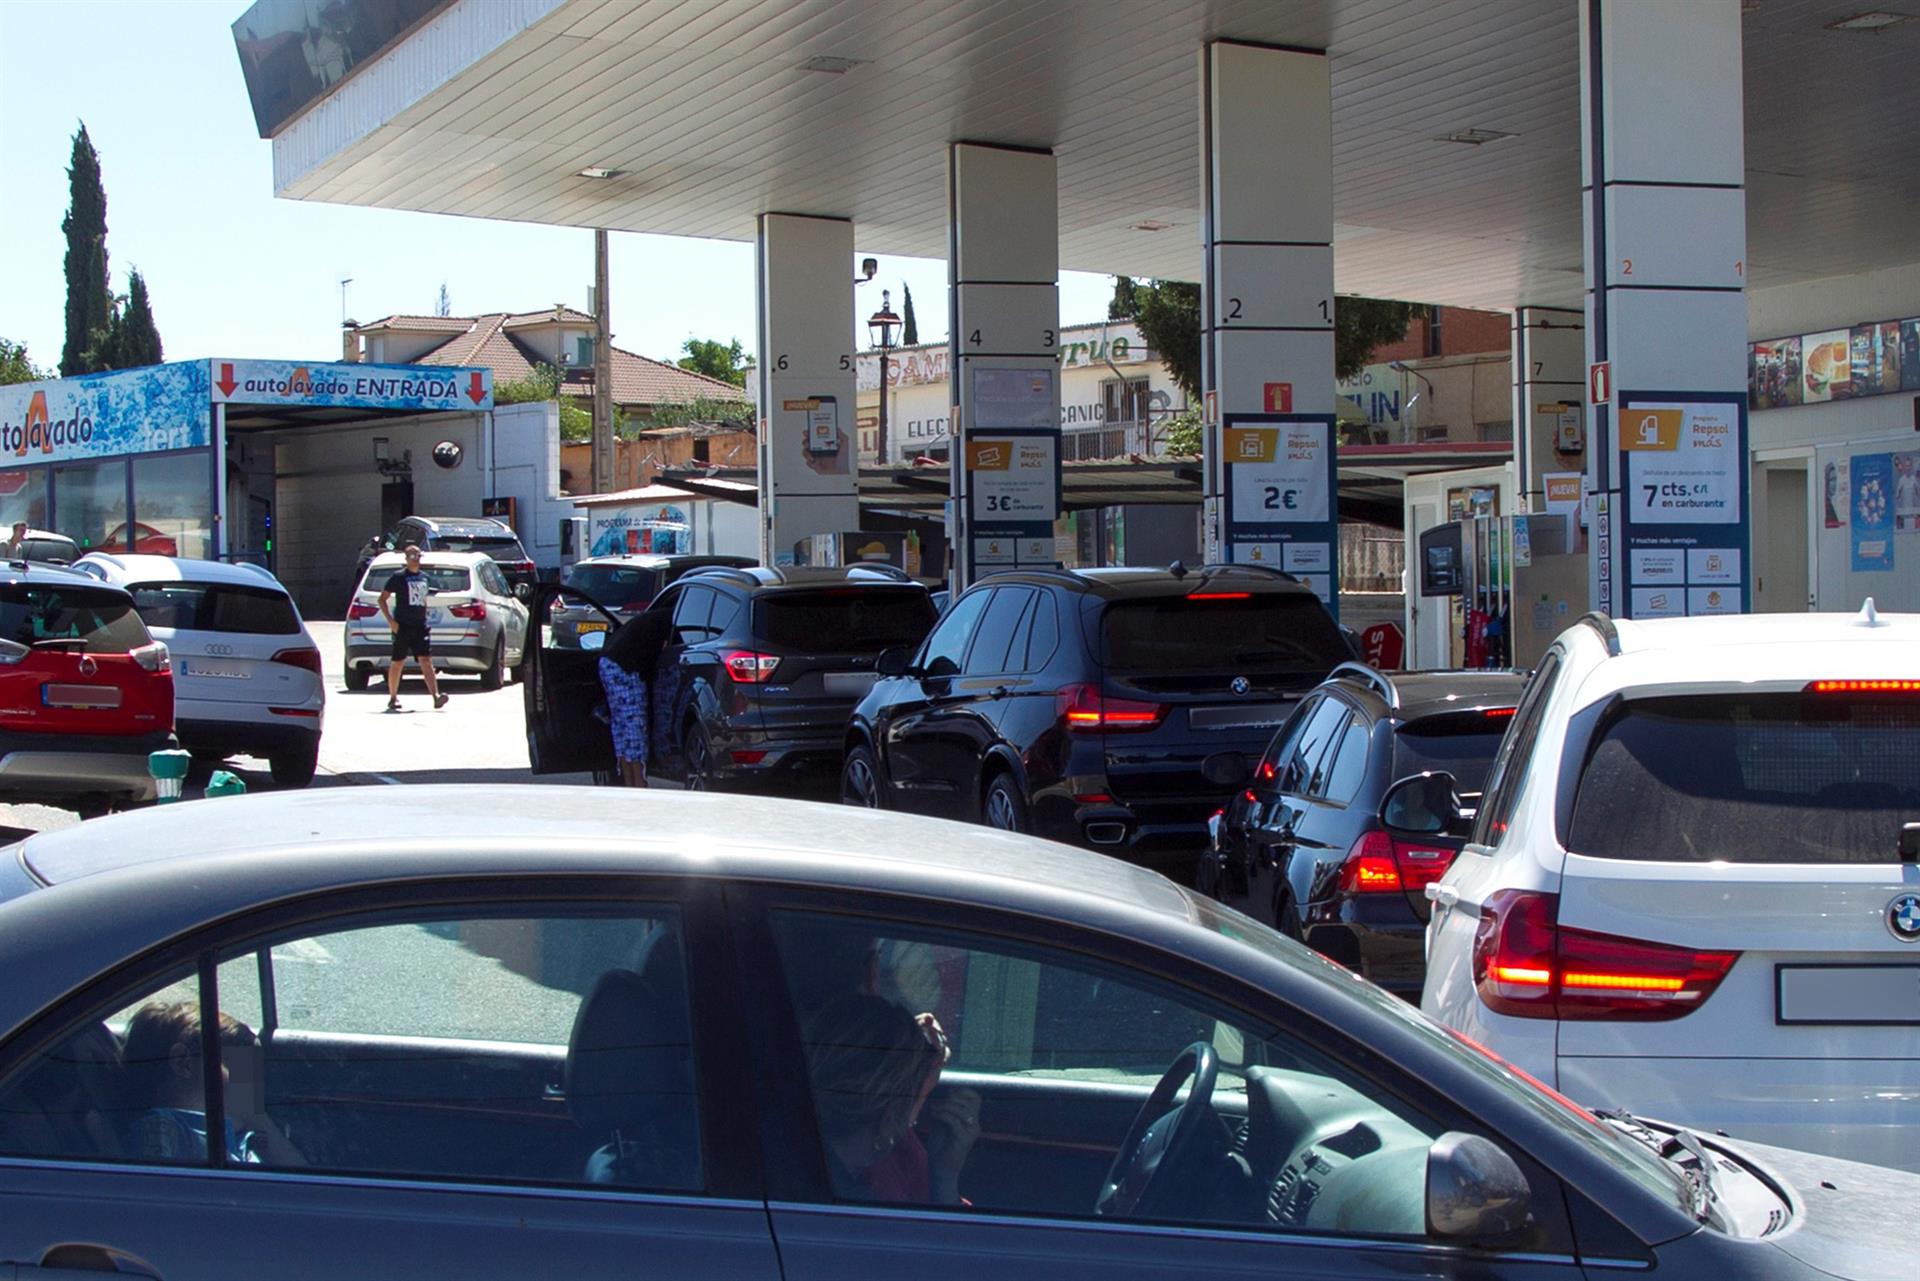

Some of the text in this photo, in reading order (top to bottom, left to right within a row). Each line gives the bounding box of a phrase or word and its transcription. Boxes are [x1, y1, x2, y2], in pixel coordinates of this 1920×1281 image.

[1622, 259, 1633, 275] 2
[1735, 261, 1743, 276] 1
[1229, 298, 1243, 319] 2
[1318, 300, 1328, 319] 1
[969, 329, 983, 346] 4
[1043, 329, 1055, 347] 3
[777, 354, 789, 370] 6
[839, 354, 850, 370] 5
[1534, 361, 1543, 376] 7
[355, 378, 458, 399] ENTRADA
[0, 402, 93, 454] tolavado
[1692, 423, 1728, 436] Repsol
[1693, 436, 1722, 448] más
[1643, 484, 1658, 507] 7
[1661, 481, 1692, 497] cts.
[986, 495, 1011, 511] 3€
[1675, 499, 1725, 508] carburante
